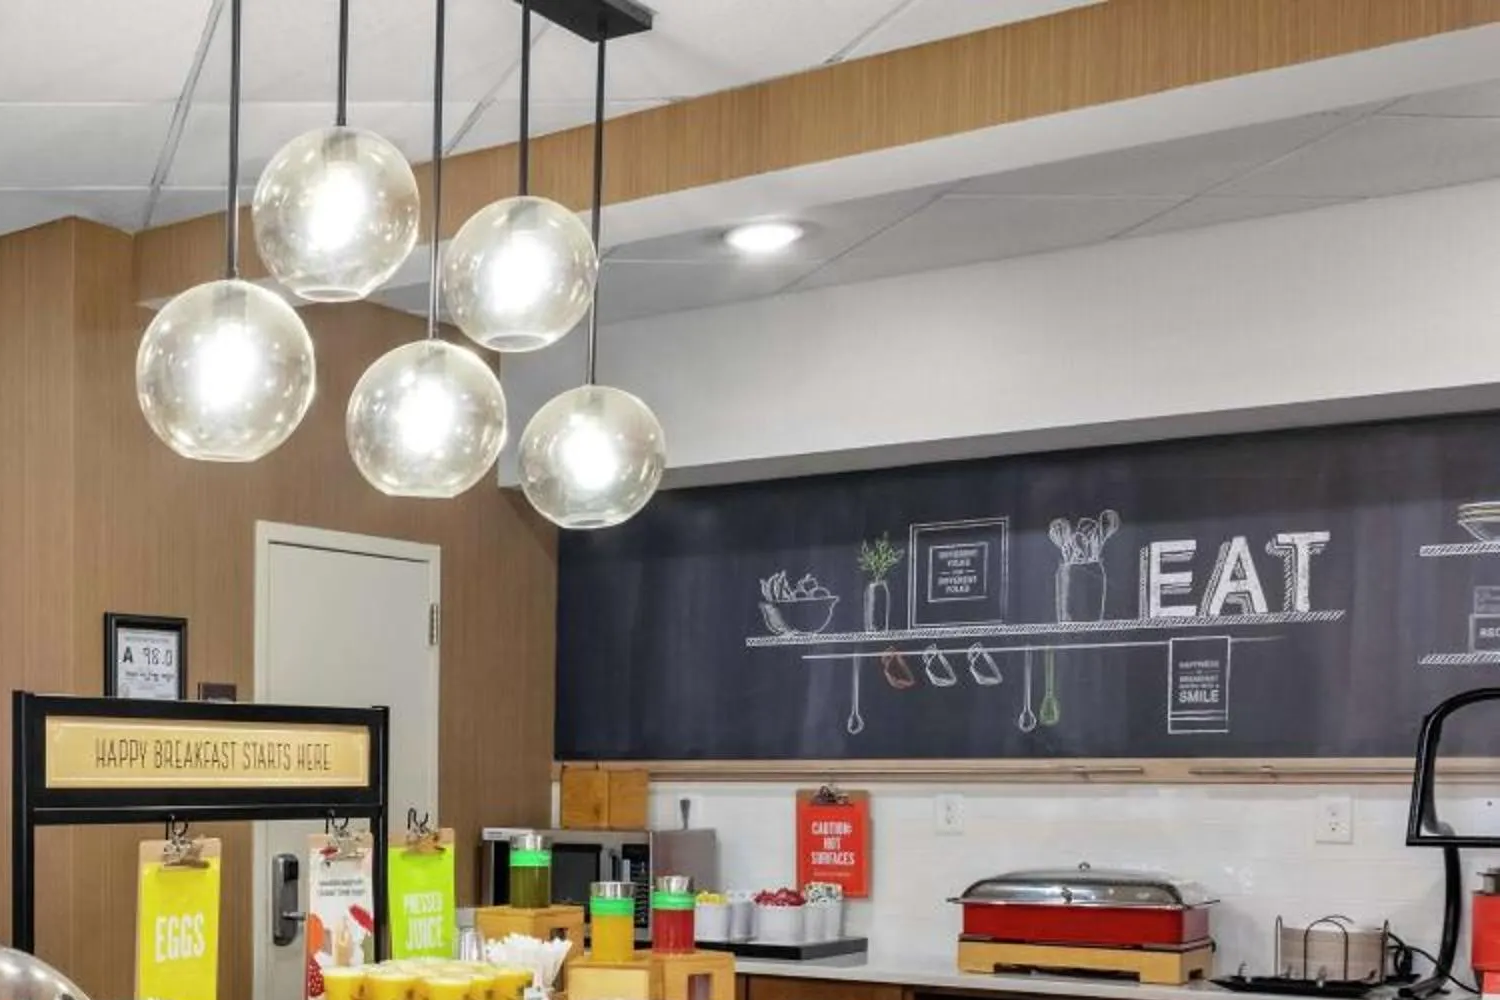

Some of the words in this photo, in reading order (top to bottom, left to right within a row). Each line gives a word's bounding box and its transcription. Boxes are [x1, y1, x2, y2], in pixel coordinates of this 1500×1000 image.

[1140, 531, 1331, 617] EAT
[123, 646, 133, 663] A
[1179, 690, 1219, 703] SMILE
[96, 737, 148, 769] HAPPY
[154, 739, 237, 770] BREAKFAST
[243, 741, 292, 771] STARTS
[297, 743, 331, 771] HERE
[155, 912, 206, 963] EGGS
[406, 916, 443, 951] JUICE
